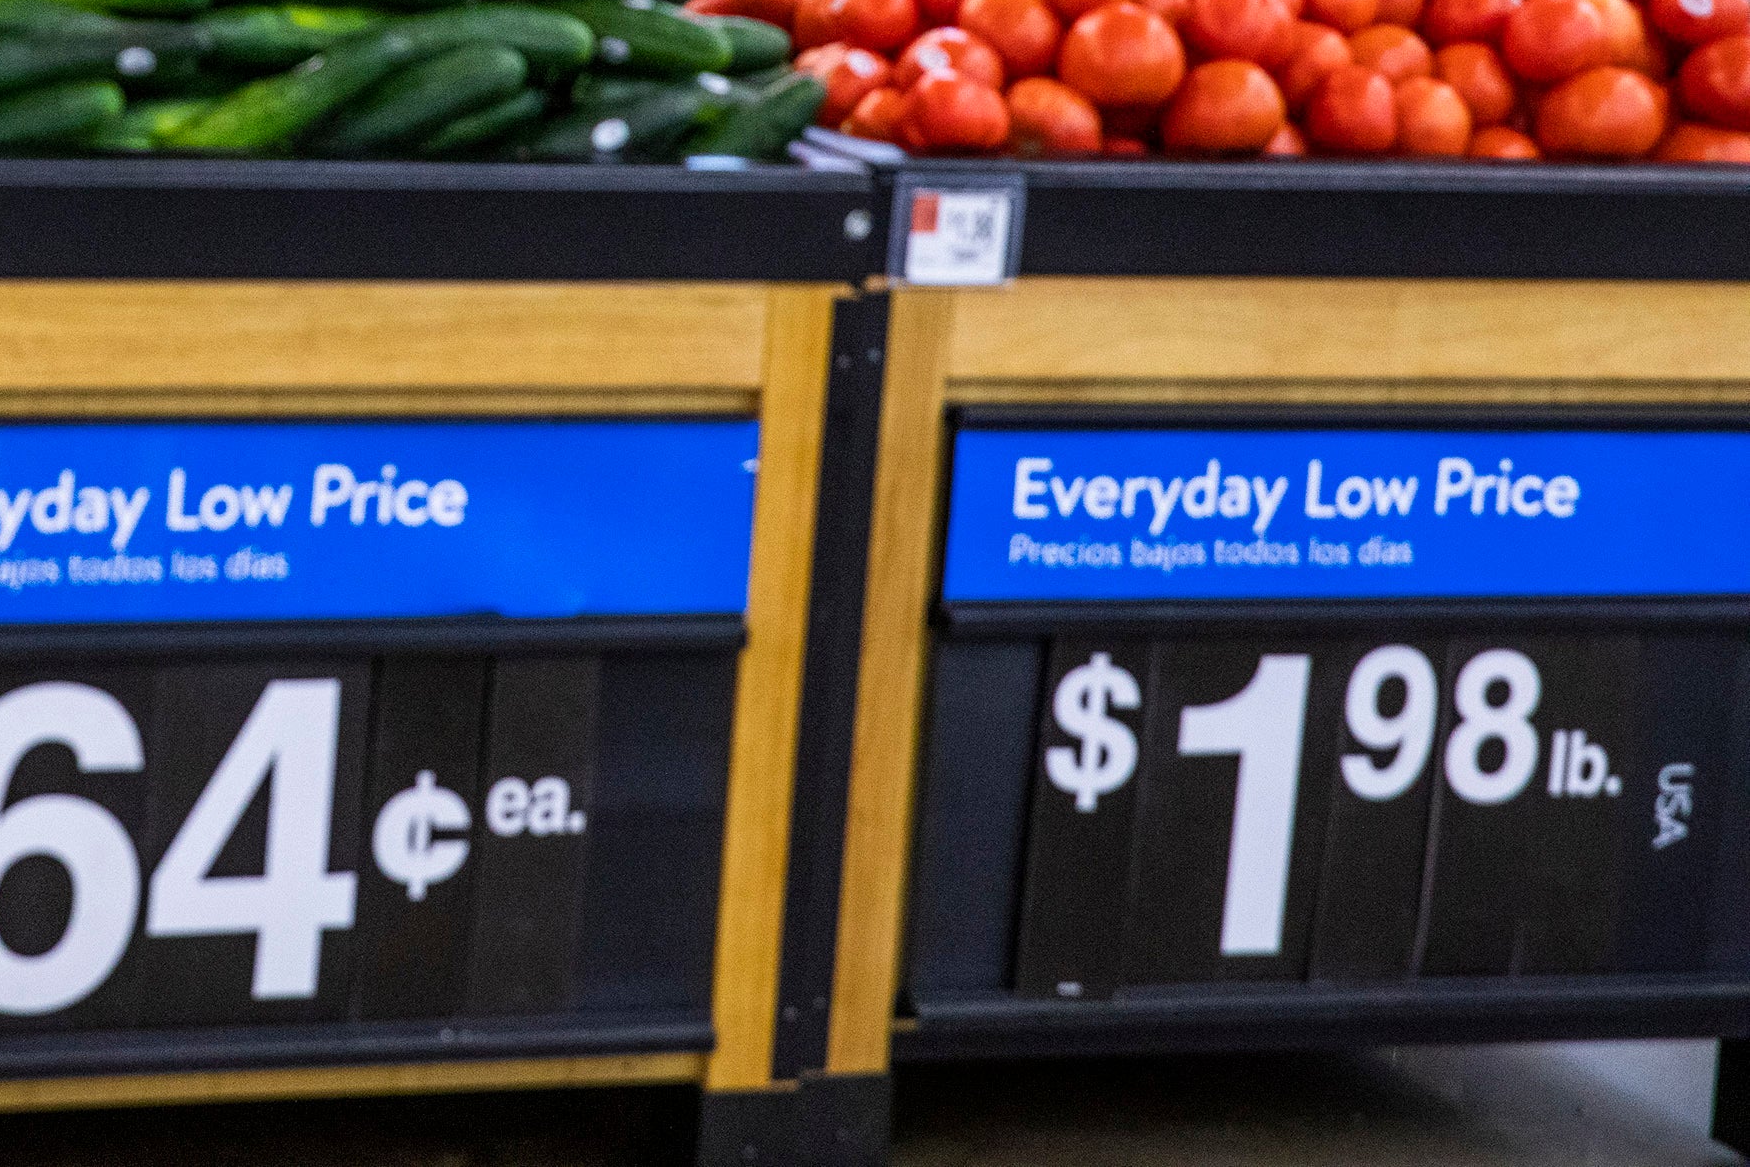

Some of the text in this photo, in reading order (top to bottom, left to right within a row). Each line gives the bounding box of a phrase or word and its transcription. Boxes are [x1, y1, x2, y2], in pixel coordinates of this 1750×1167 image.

[166, 467, 292, 531] Low
[310, 463, 468, 527] Price
[1013, 456, 1580, 536] Everyday Low Price
[67, 552, 164, 584] todos
[171, 549, 218, 582] los
[1008, 534, 1122, 567] Precios
[1130, 536, 1207, 574] bajos
[1214, 537, 1300, 566] todos
[1309, 536, 1350, 565] los
[1547, 730, 1622, 797] lb.
[485, 775, 587, 835] ea.
[1652, 761, 1697, 850] USA
